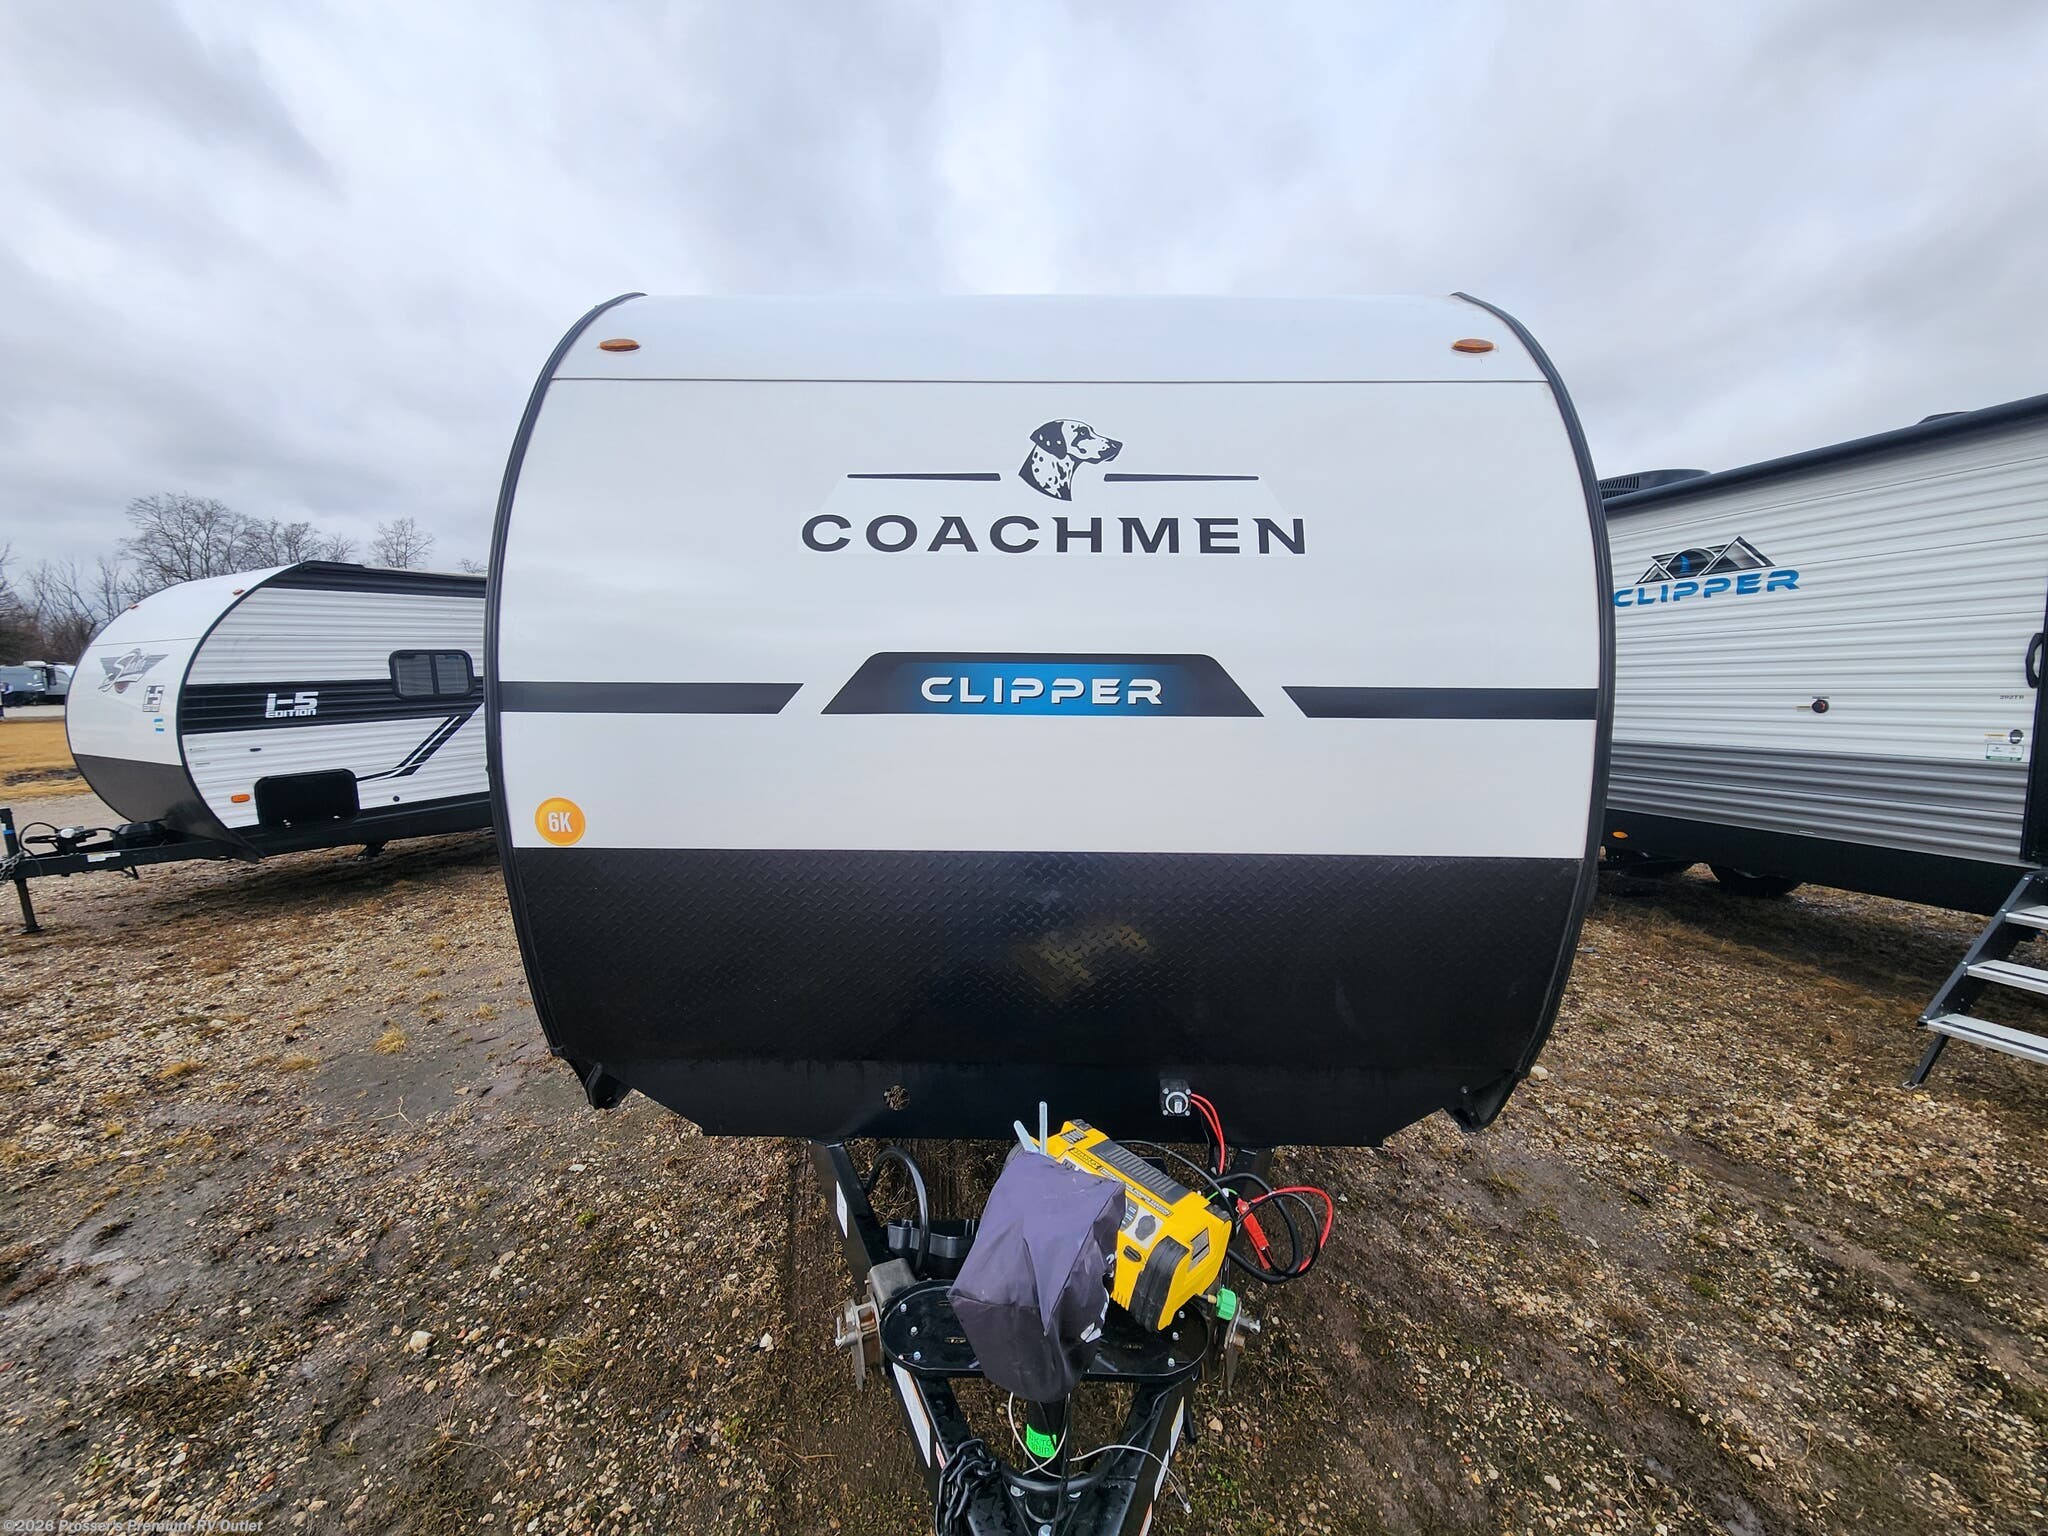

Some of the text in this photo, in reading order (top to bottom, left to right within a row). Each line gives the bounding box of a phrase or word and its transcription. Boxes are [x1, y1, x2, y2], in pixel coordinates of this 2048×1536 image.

[801, 514, 1306, 555] COACHMEN
[1614, 569, 1800, 607] CLIPPER
[921, 677, 1162, 705] CLIPPER
[265, 708, 317, 719] EDITION
[548, 811, 573, 833] 6K
